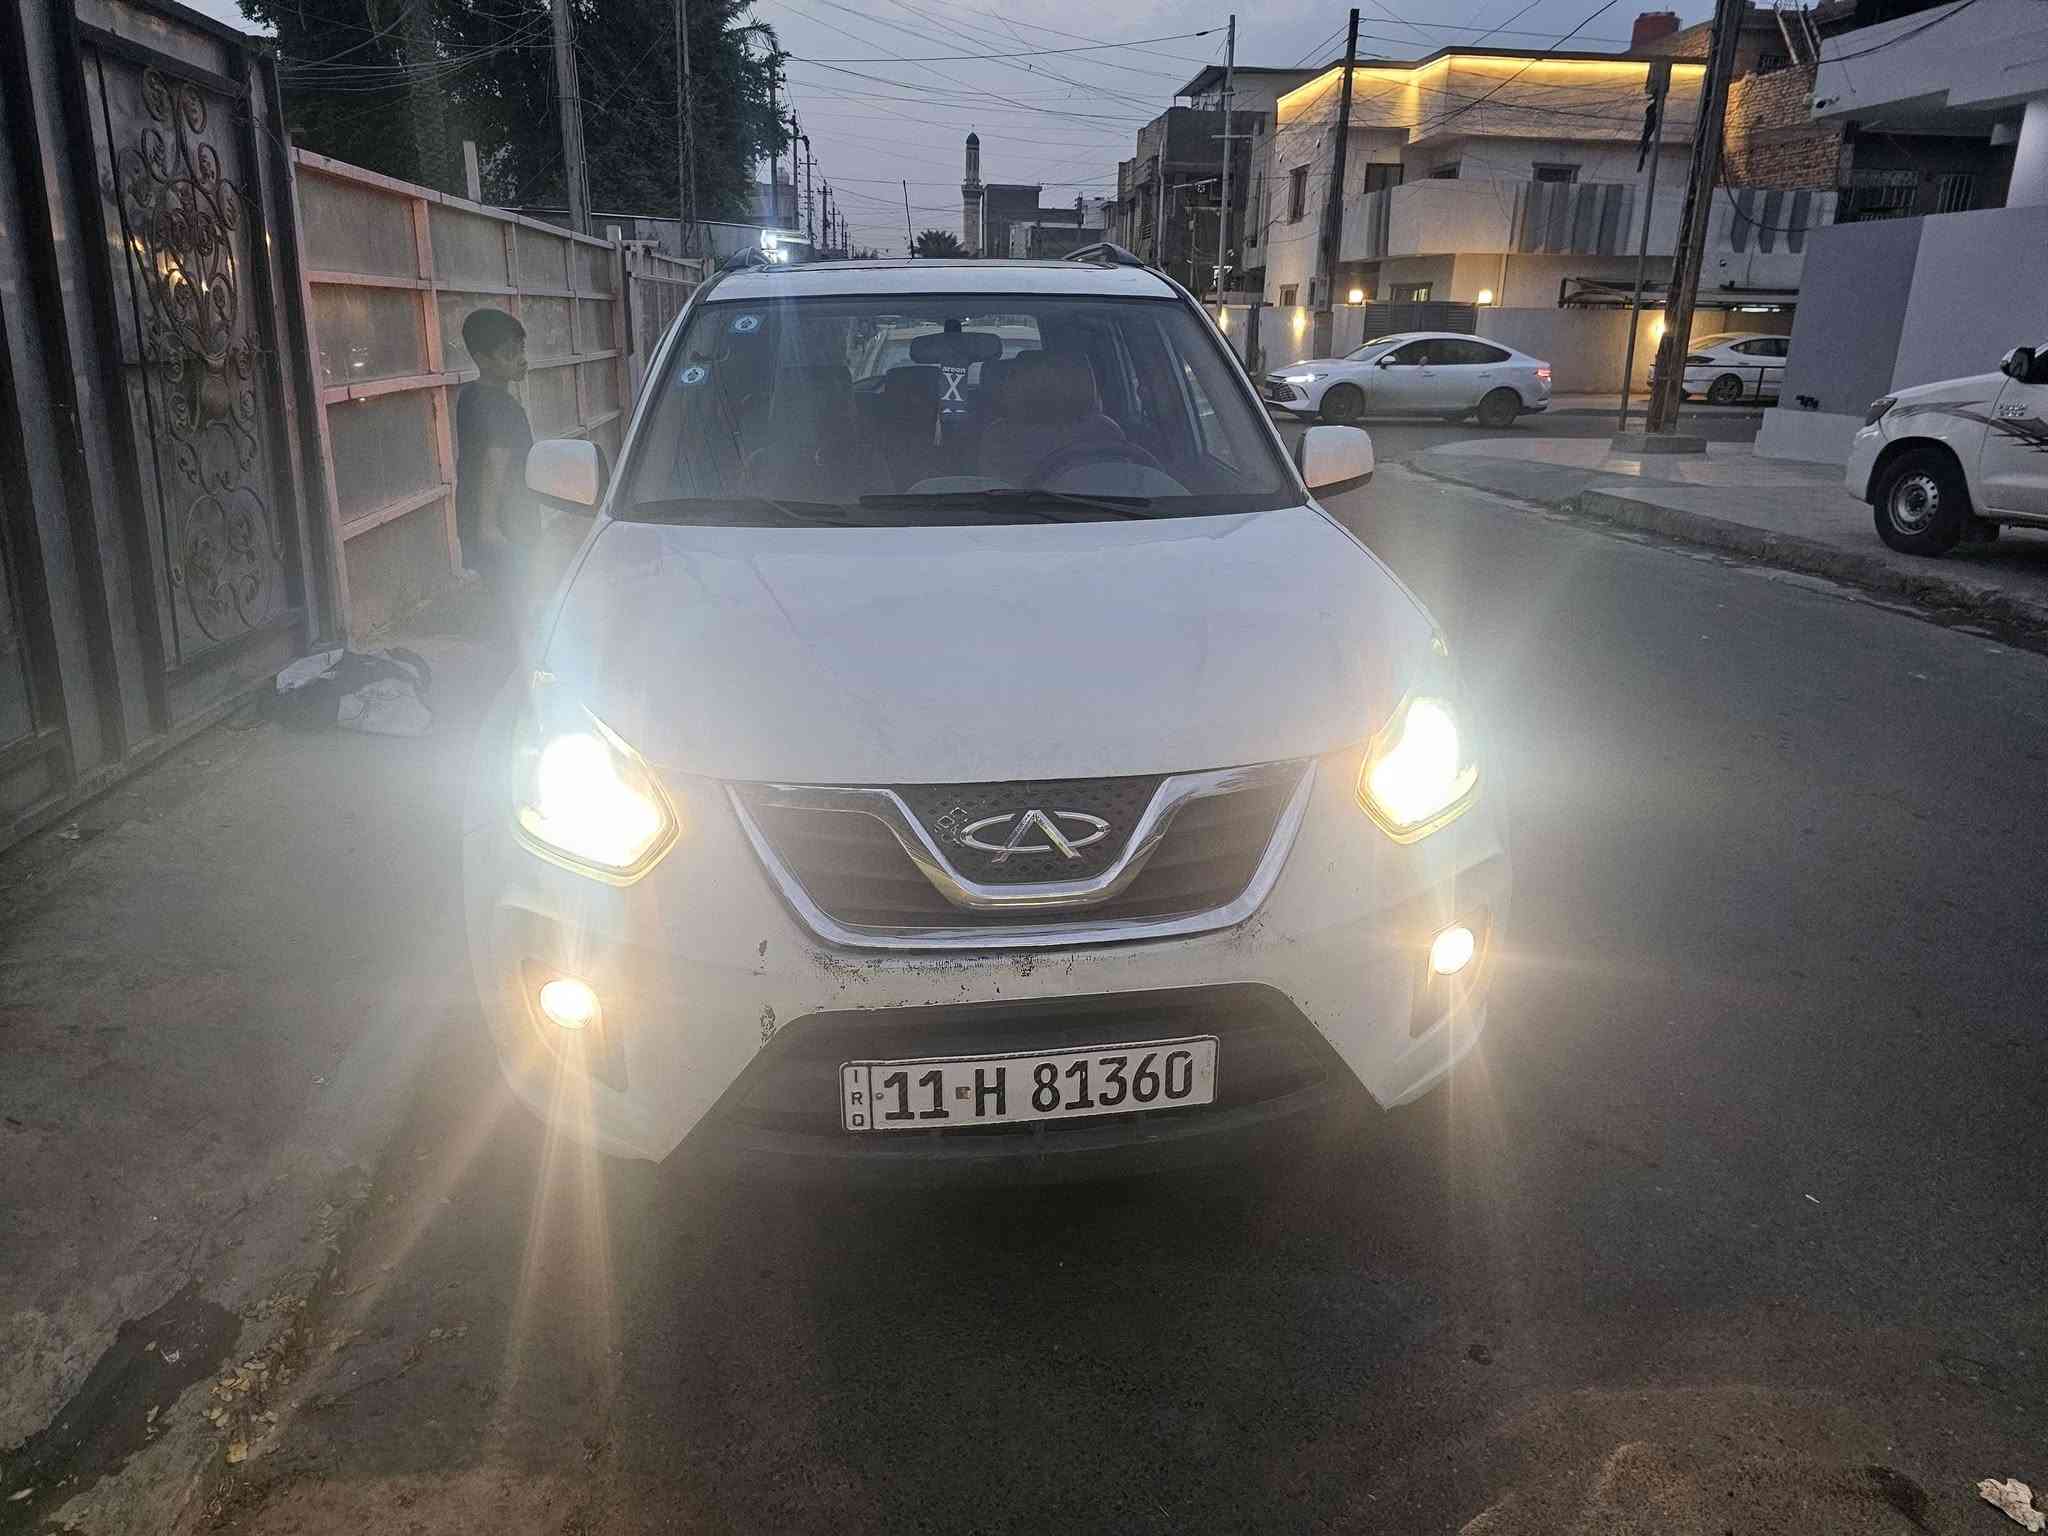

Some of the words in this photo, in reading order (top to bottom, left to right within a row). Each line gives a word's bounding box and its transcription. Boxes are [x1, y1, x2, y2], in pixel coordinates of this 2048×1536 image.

[883, 1070, 949, 1121] 11
[974, 1067, 1007, 1117] H
[1031, 1050, 1193, 1112] 81360
